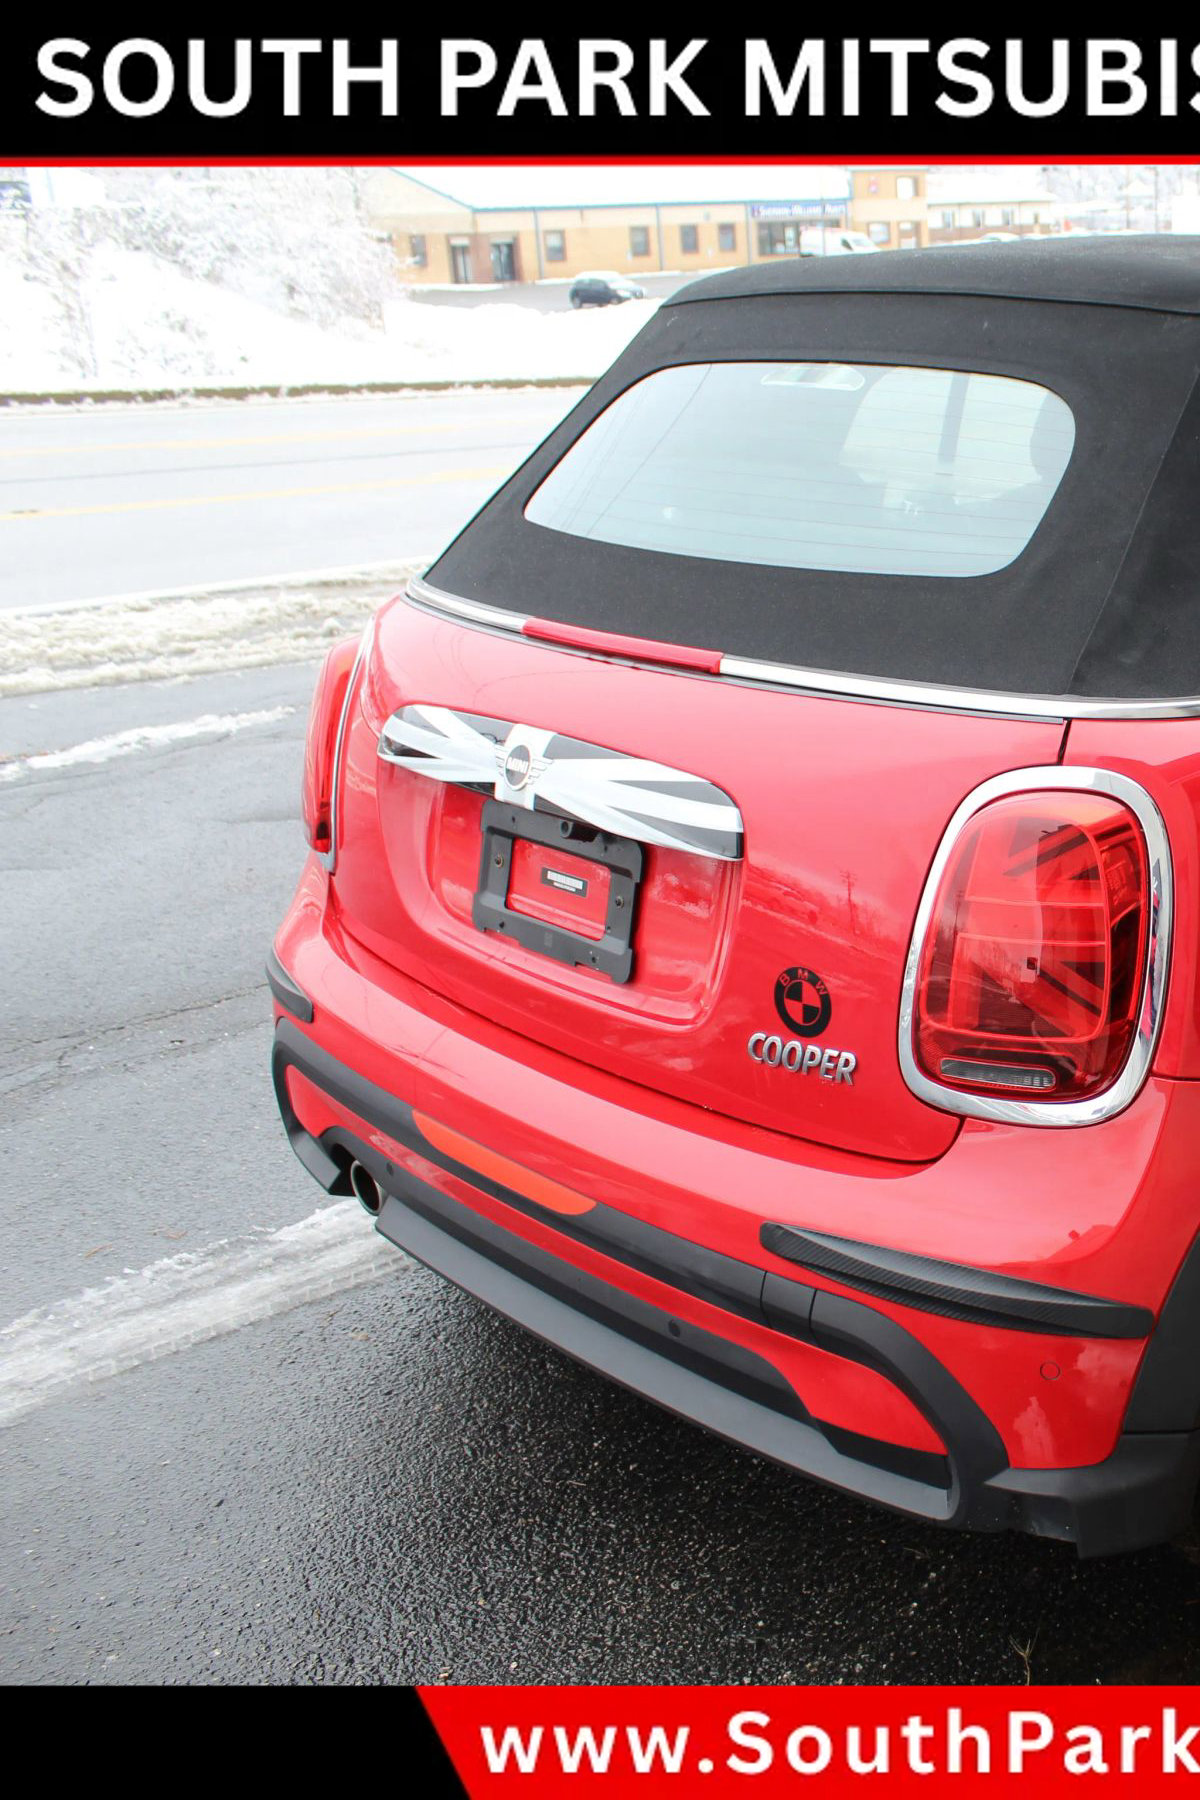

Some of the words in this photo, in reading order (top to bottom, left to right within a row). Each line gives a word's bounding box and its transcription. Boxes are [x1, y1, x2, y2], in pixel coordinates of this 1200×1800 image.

[507, 756, 529, 774] MINI
[779, 968, 828, 995] BMW
[748, 1032, 857, 1085] COOPER
